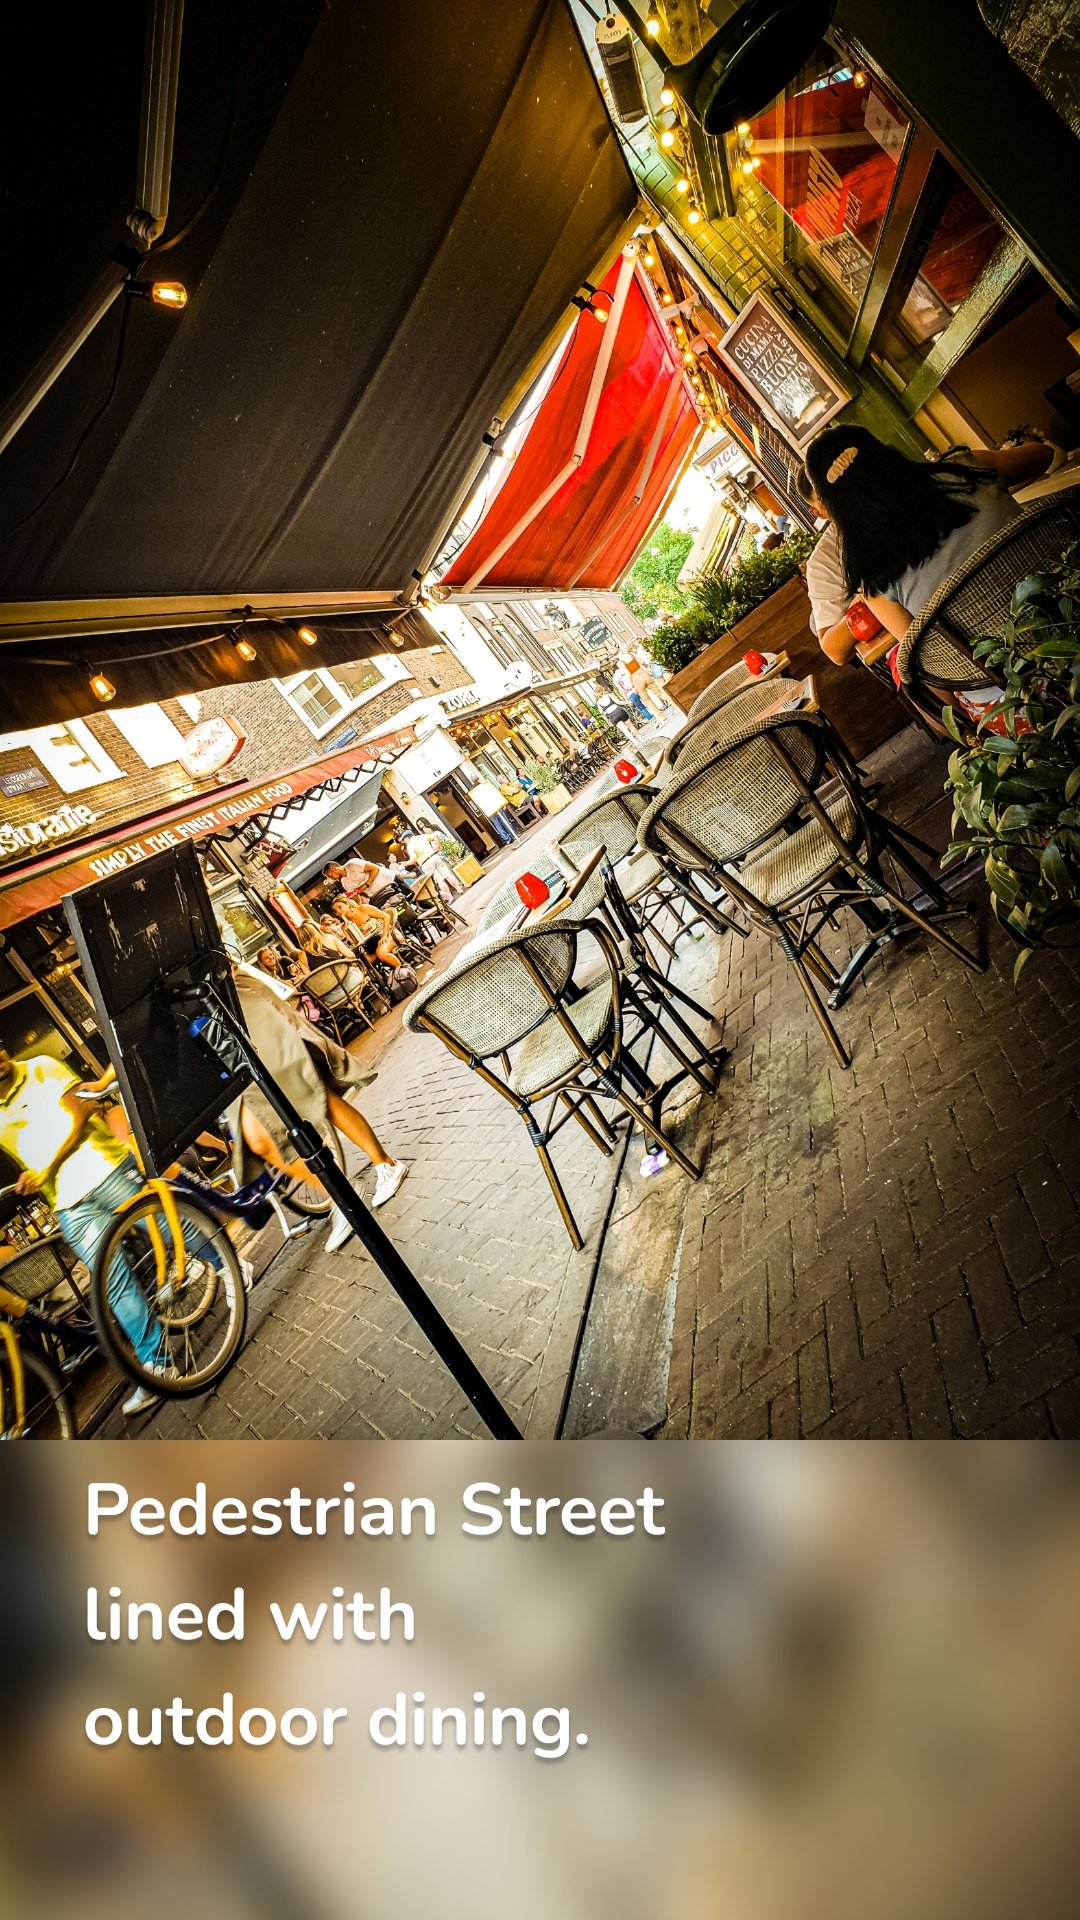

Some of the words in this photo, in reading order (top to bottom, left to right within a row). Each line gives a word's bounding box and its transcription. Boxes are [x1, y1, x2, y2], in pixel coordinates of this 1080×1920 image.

[844, 190, 863, 230] PIZZA
[734, 315, 771, 360] CUCINA
[743, 356, 754, 369] DI
[750, 332, 774, 361] MAMA
[769, 325, 798, 363] PASTA
[750, 342, 784, 382] PIZZA
[760, 353, 796, 395] BUON
[89, 843, 147, 877] SIMPLY
[146, 830, 178, 852] THE
[174, 812, 221, 838] FINEST
[217, 795, 266, 821] ITALIAN
[262, 782, 293, 803] FOOD
